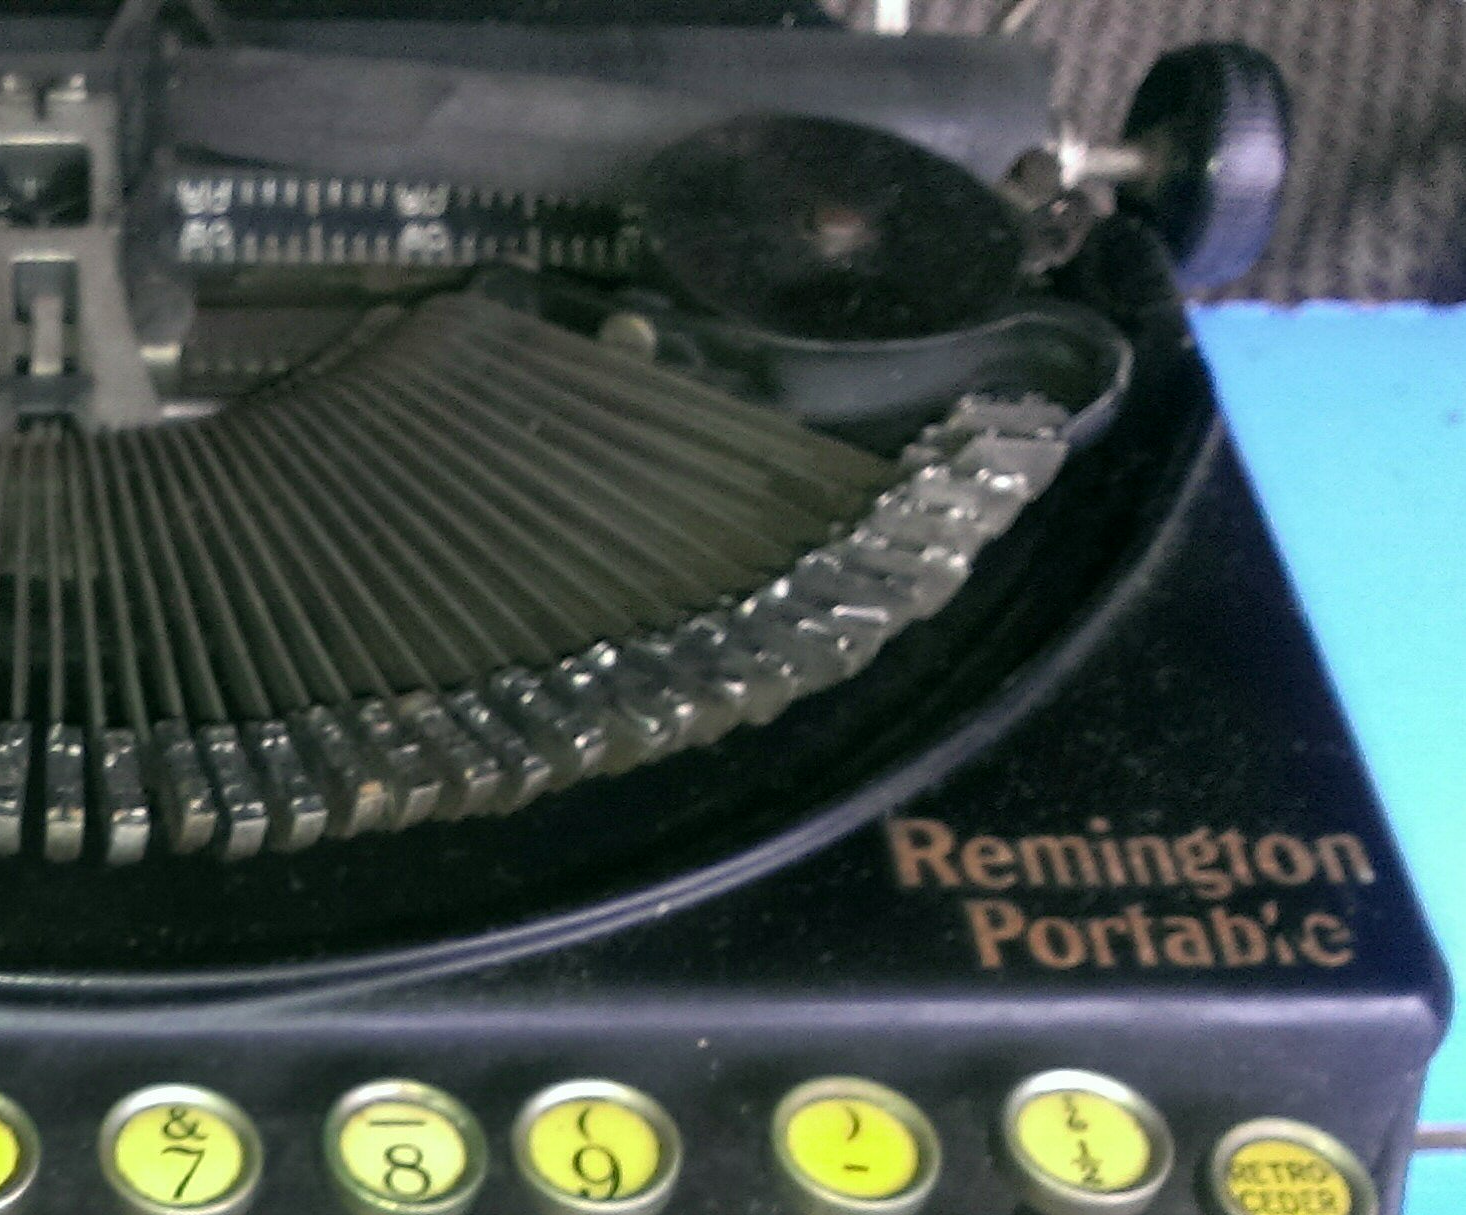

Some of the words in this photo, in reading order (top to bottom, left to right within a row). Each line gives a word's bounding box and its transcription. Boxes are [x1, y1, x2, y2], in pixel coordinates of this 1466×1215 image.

[887, 815, 1376, 900] Remington
[161, 1105, 209, 1141] &
[162, 1145, 206, 1200] 7
[383, 1143, 432, 1198] 8
[572, 1144, 622, 1202] 9
